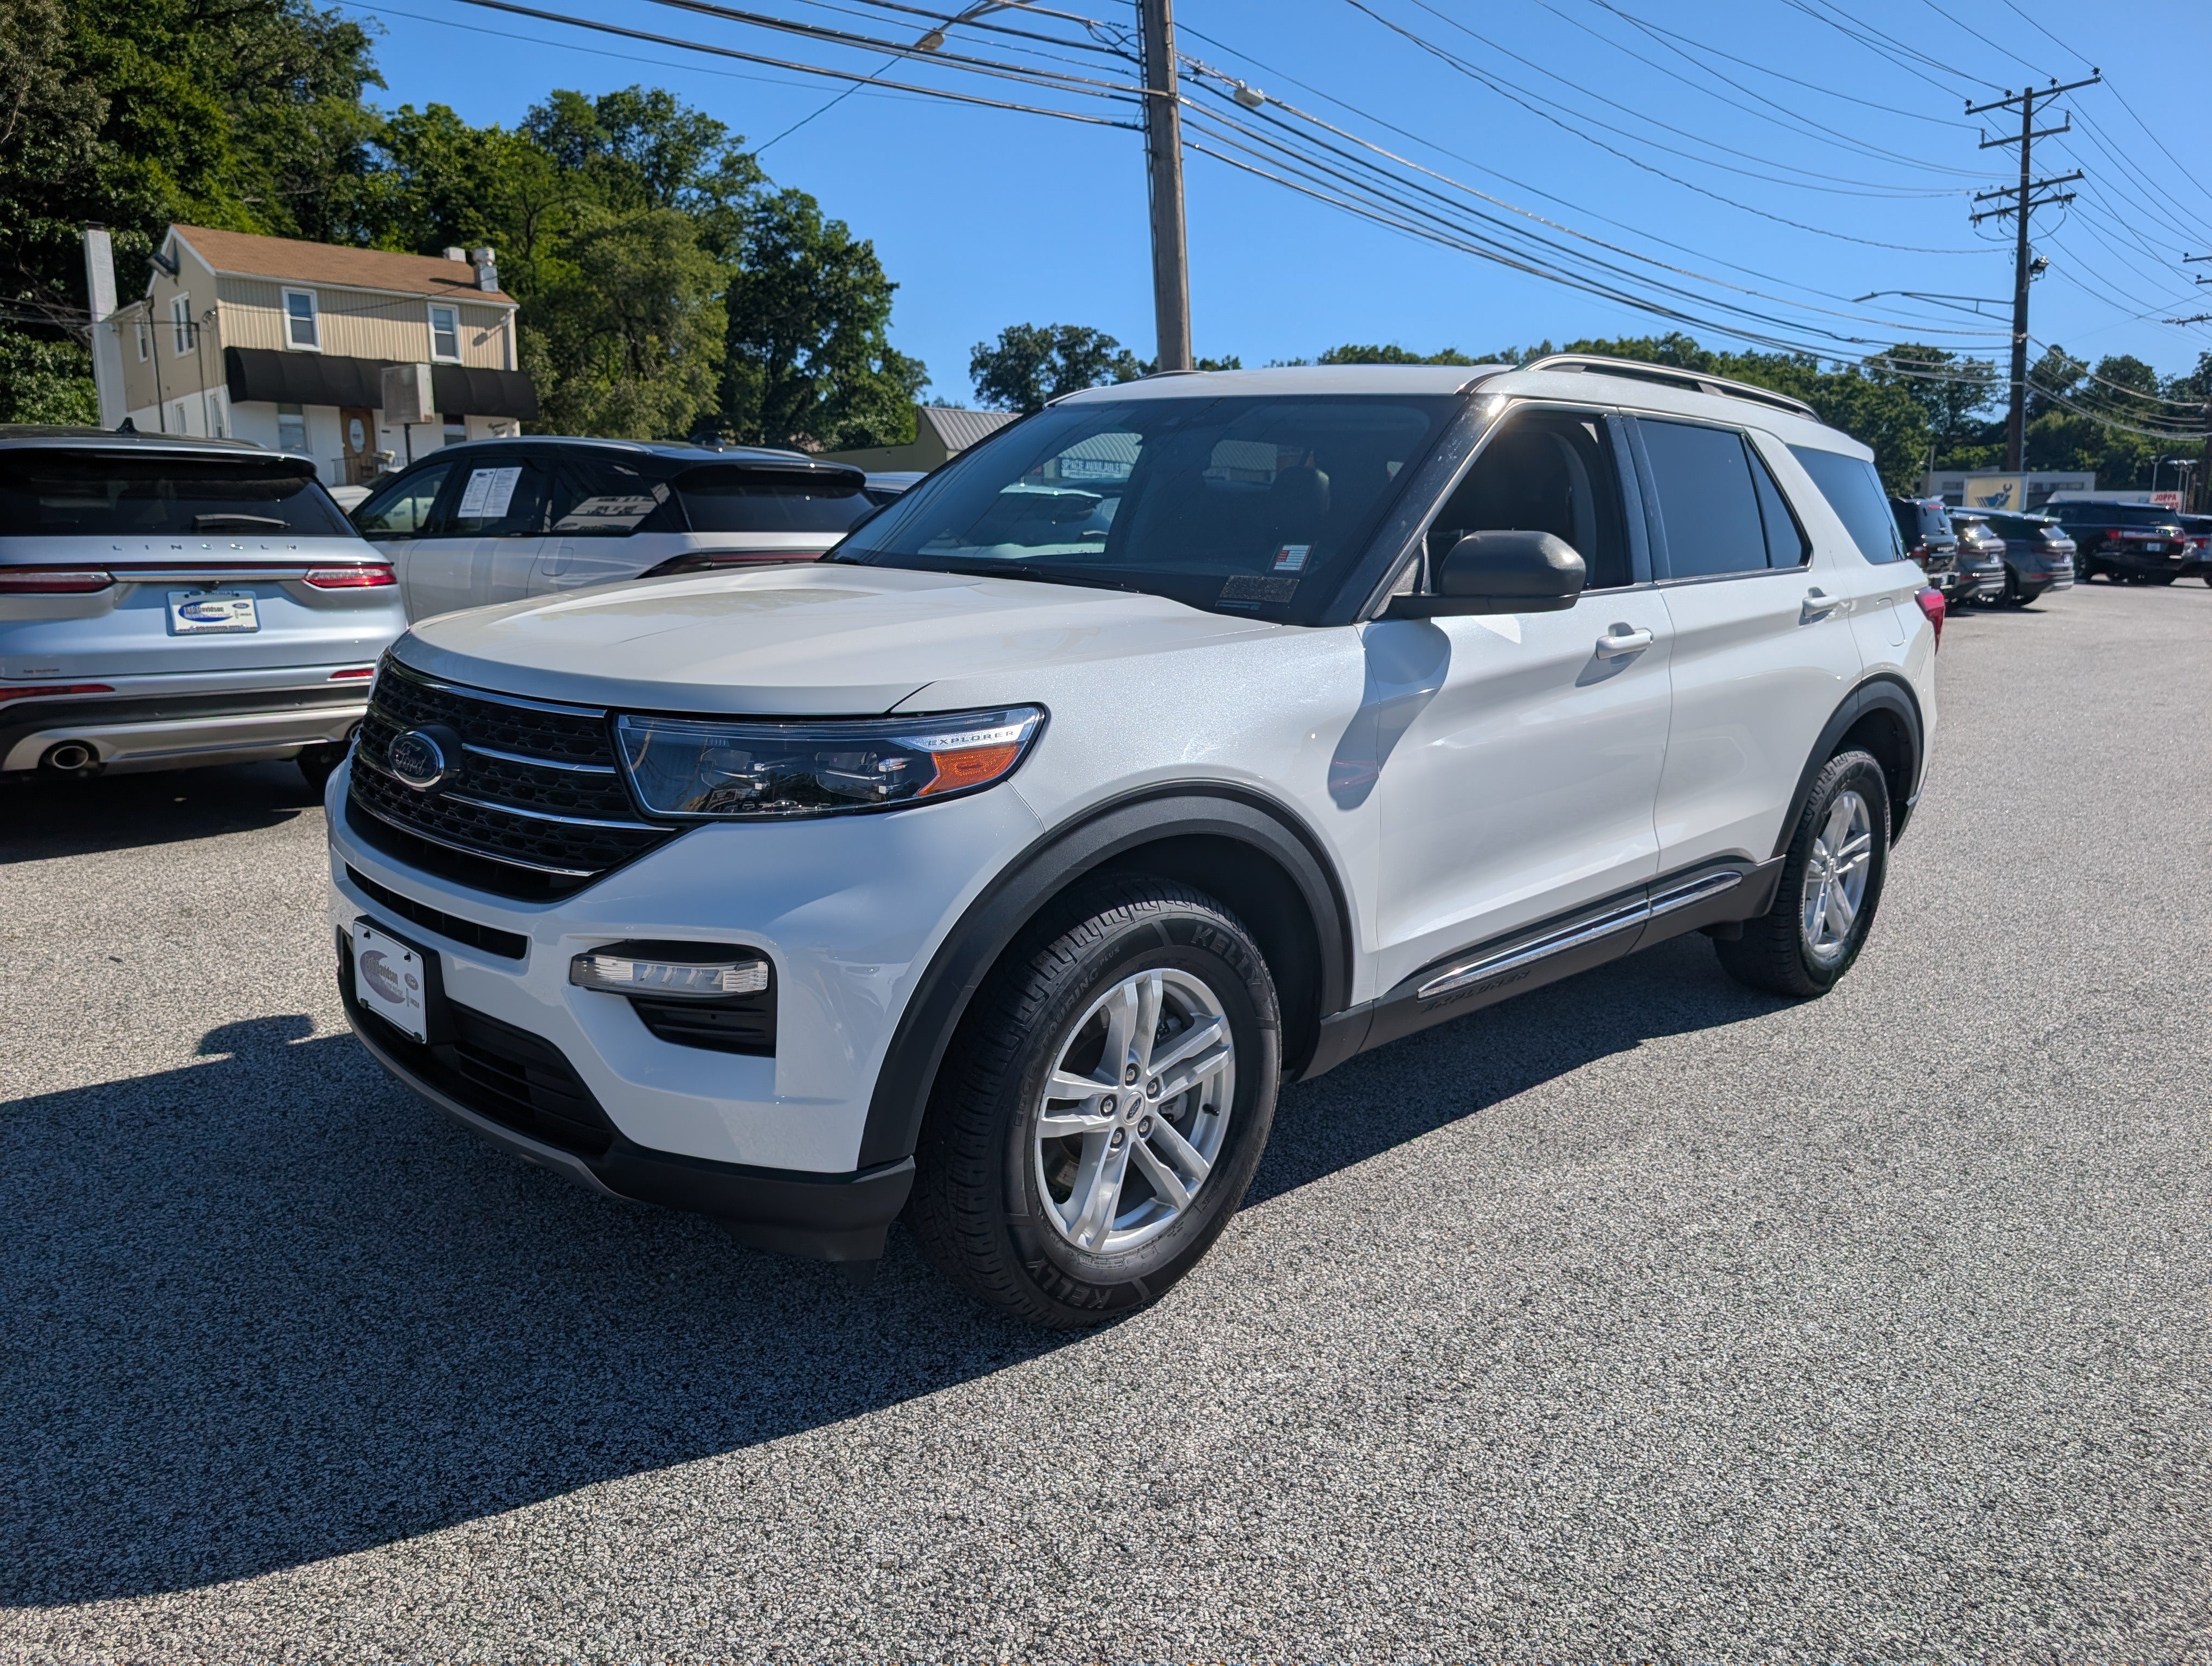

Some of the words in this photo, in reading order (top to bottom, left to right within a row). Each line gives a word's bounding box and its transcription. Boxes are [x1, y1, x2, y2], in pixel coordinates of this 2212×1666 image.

[2154, 493, 2176, 501] JOPPA
[394, 741, 427, 776] Ford
[928, 731, 1014, 746] EXPLORER
[1191, 925, 1262, 988] KELLY
[1039, 967, 1099, 1050] TOURING
[1099, 946, 1121, 967] PLUS
[1026, 1257, 1114, 1310] KELLY
